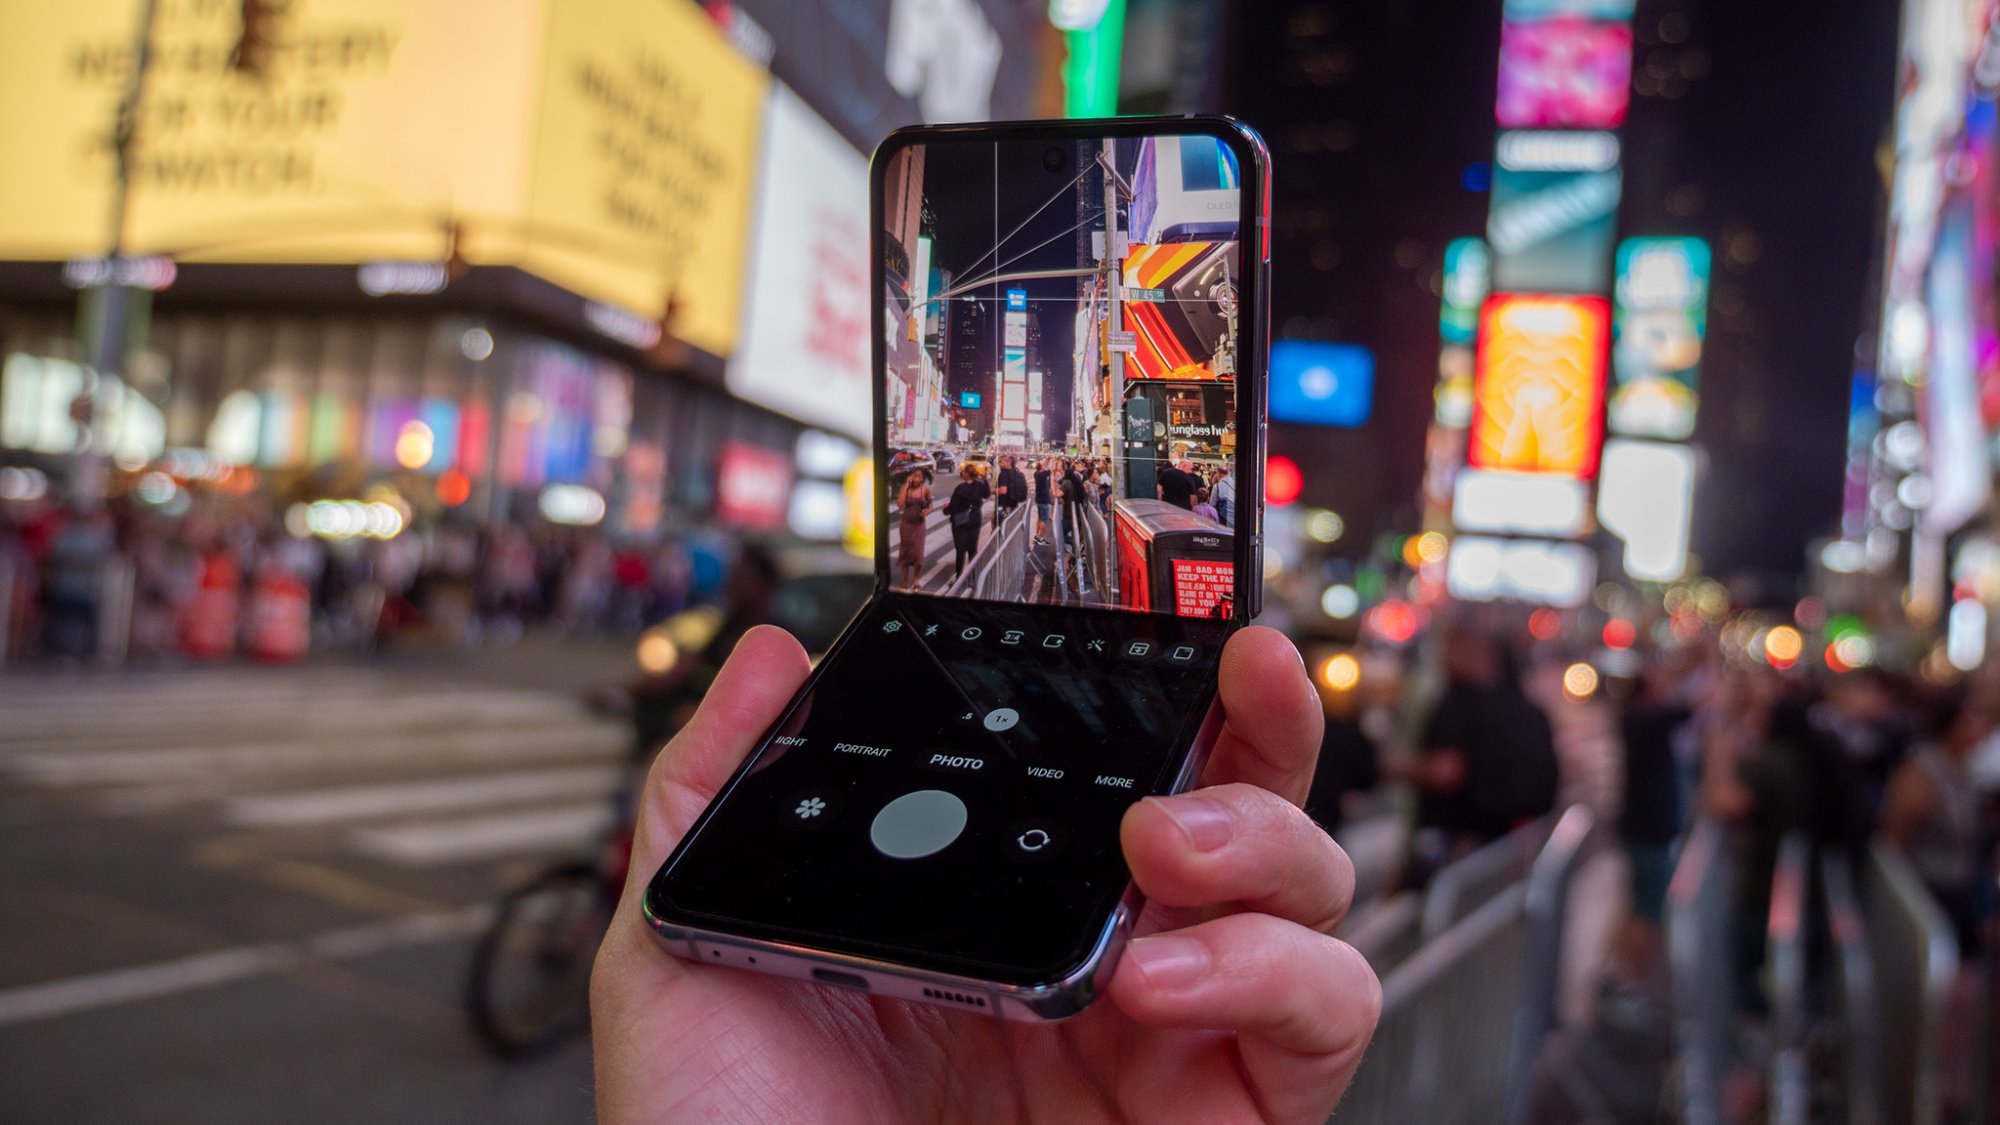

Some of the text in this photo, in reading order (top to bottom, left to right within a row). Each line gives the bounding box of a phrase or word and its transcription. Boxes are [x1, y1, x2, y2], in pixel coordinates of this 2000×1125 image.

[1206, 201, 1233, 210] OLED
[1143, 290, 1154, 300] 45
[1180, 598, 1196, 606] CAN
[962, 712, 973, 720] .5
[833, 743, 892, 757] PORTRAIT
[930, 754, 984, 769] PHOTO
[1027, 766, 1064, 779] VIDEO
[1095, 775, 1134, 788] MORE
